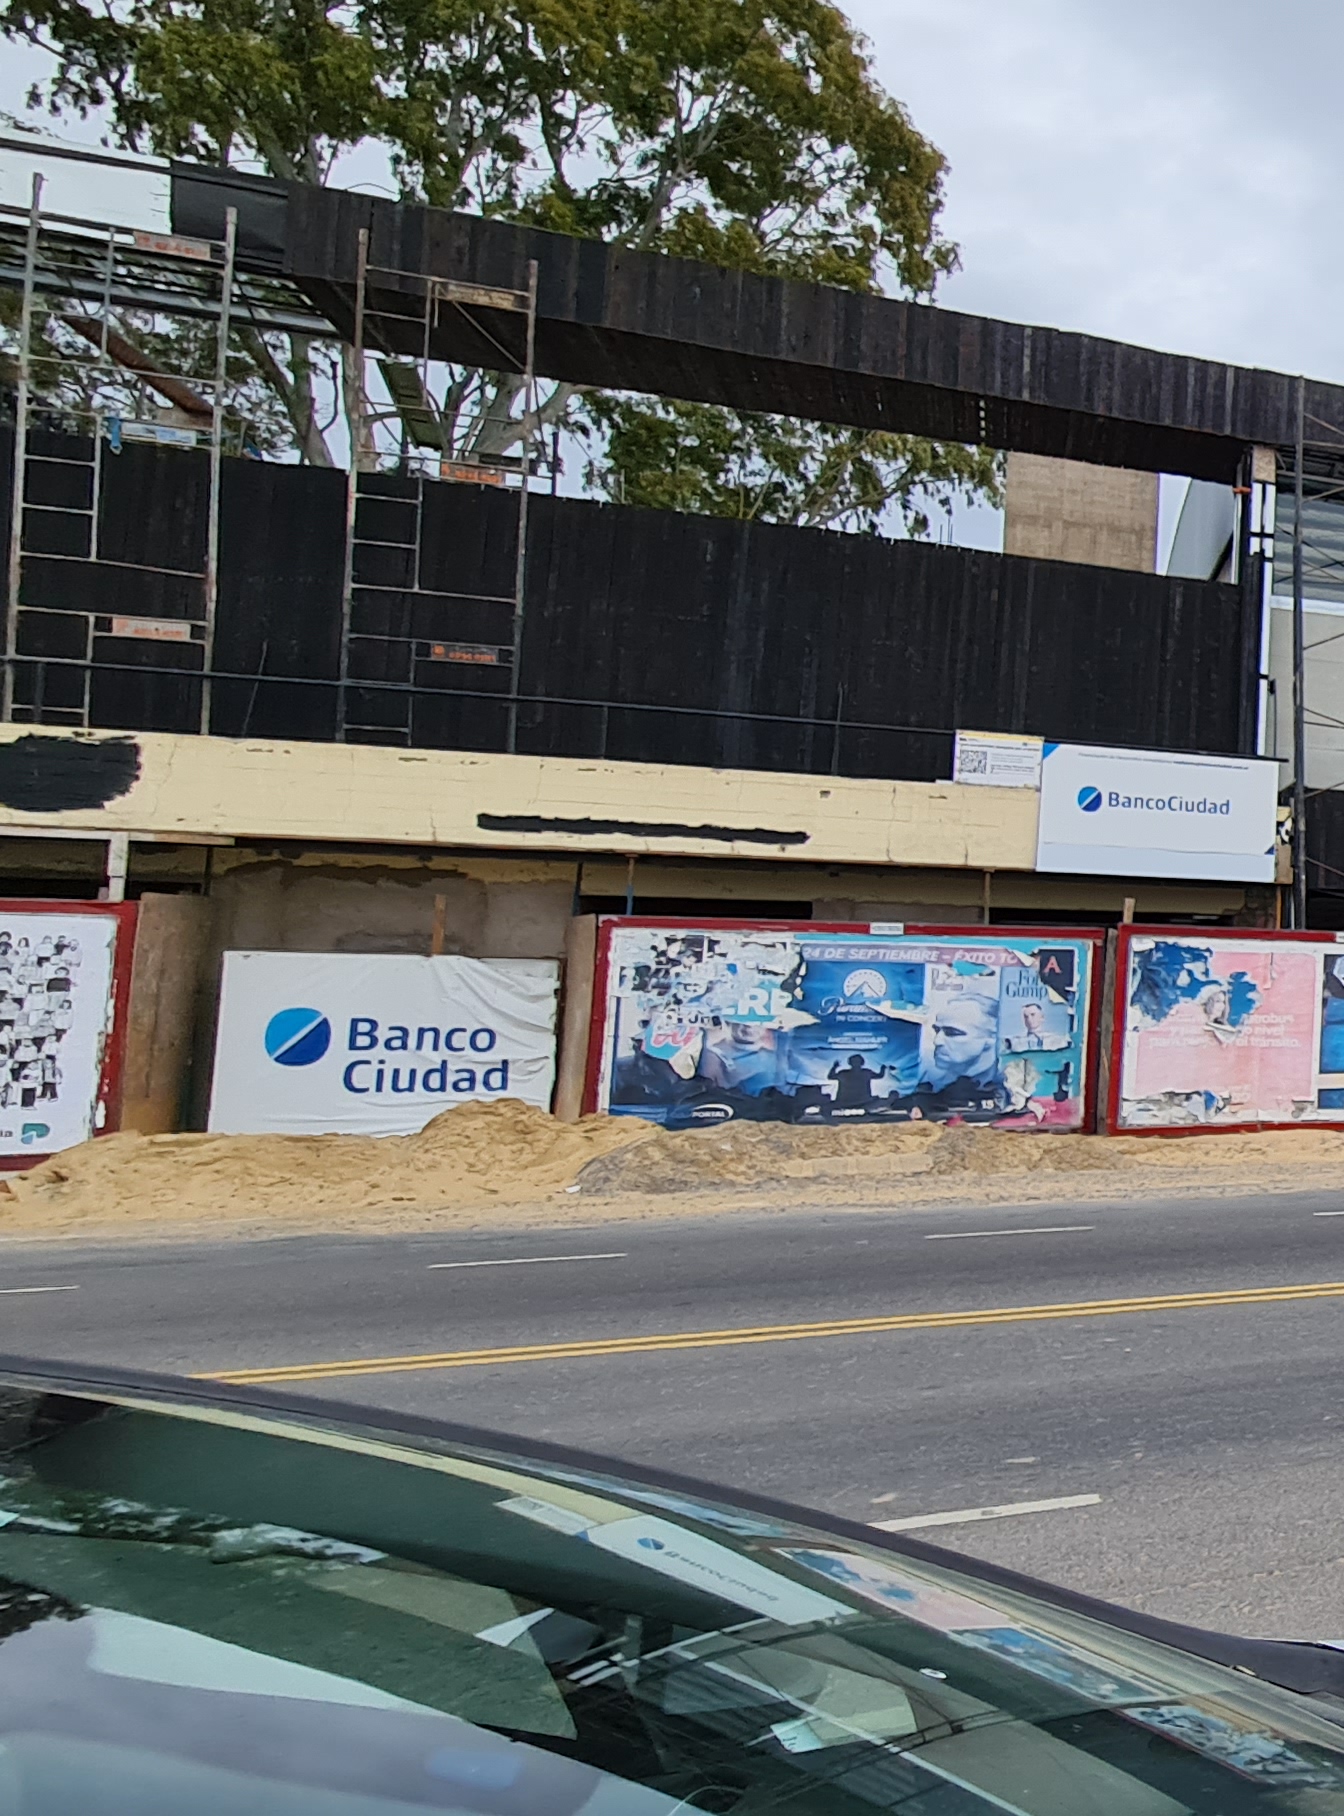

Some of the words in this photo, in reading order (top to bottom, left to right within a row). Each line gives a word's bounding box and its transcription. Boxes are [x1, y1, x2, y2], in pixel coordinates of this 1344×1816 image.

[1108, 791, 1230, 815] BancoCiudad
[828, 948, 846, 959] DE
[848, 948, 938, 962] SEPTIEMBRE
[347, 1017, 498, 1053] Banco
[342, 1059, 510, 1093] Ciudad
